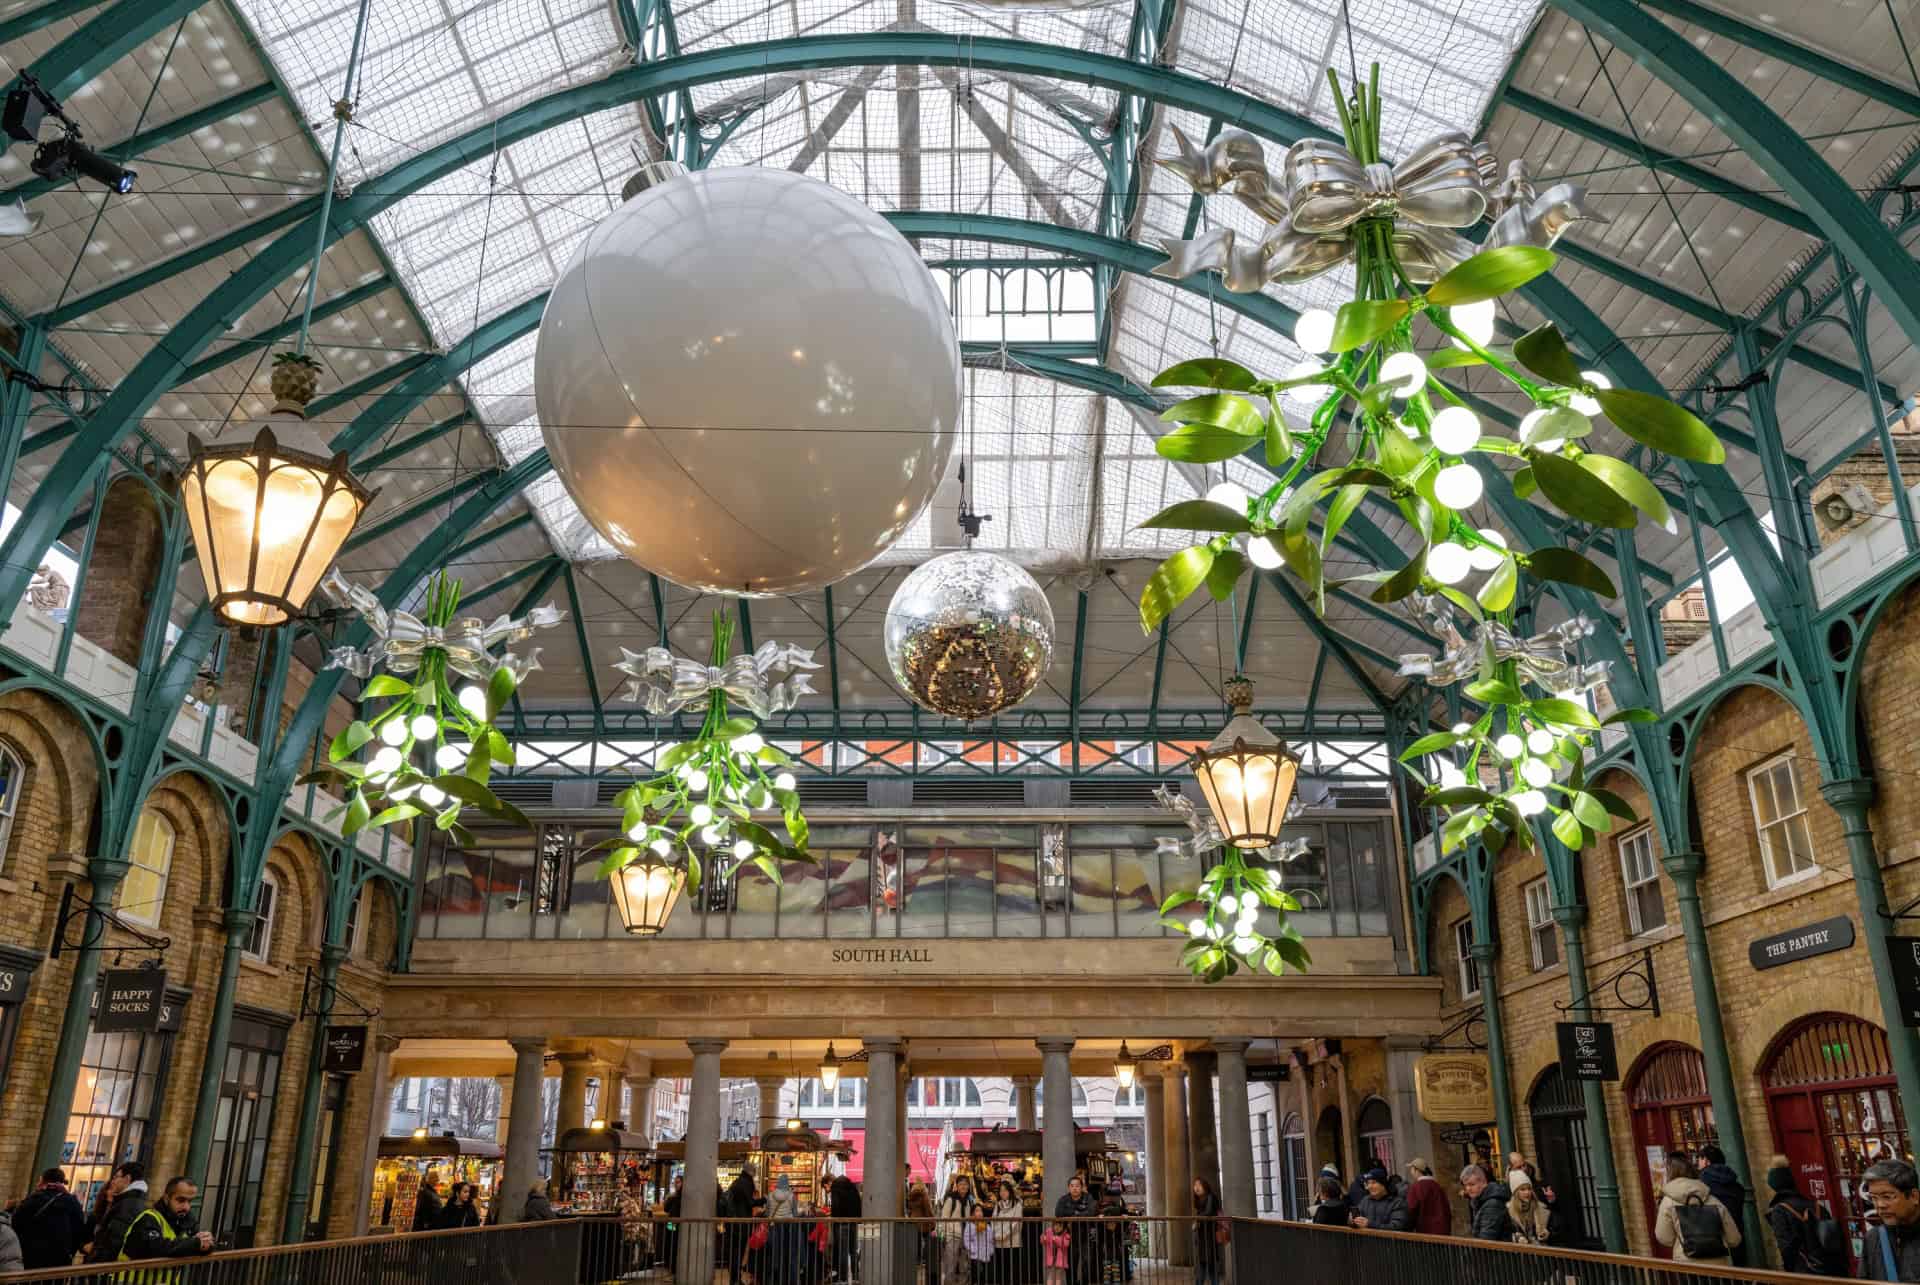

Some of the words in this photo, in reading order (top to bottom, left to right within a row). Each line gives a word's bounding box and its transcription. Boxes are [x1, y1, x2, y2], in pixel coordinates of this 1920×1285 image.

[1766, 942, 1787, 957] THE
[1789, 930, 1829, 952] PANTRY
[832, 949, 885, 962] SOUTH
[889, 949, 934, 962] HALL
[111, 990, 152, 1000] HAPPY
[109, 1002, 150, 1013] SOCKS
